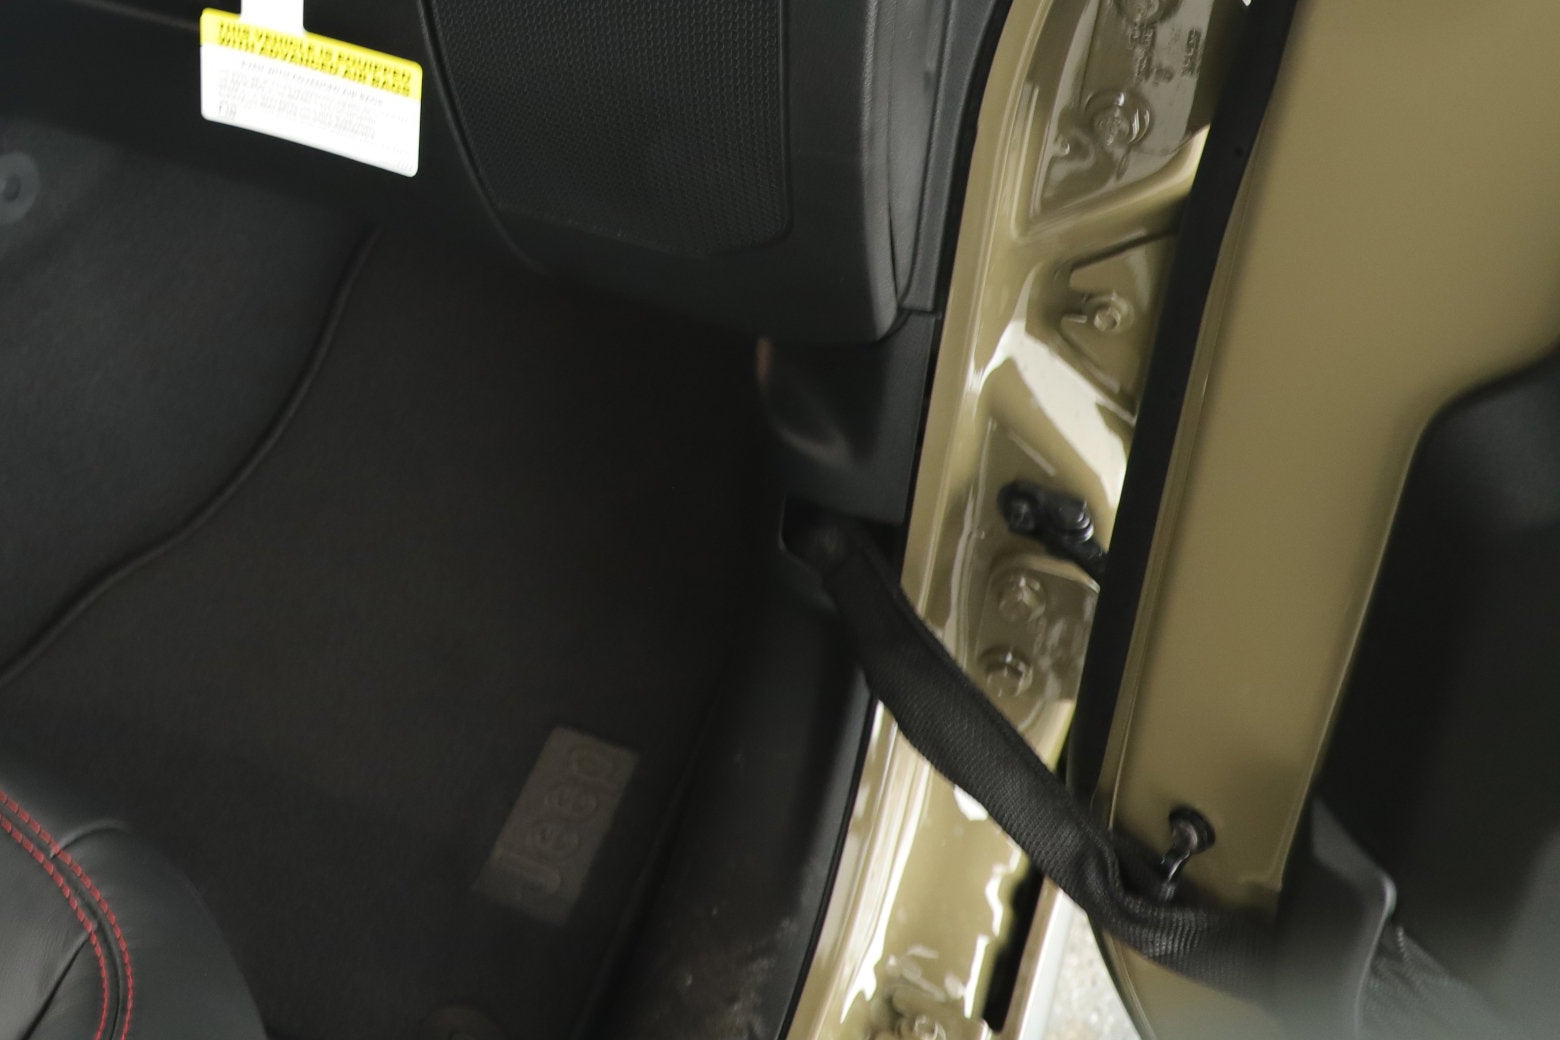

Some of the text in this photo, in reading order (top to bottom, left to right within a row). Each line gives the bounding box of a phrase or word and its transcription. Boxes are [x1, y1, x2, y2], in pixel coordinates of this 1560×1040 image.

[219, 21, 250, 40] THIS
[256, 31, 313, 57] VEHICLE
[336, 53, 411, 84] EQUIPPED
[219, 34, 411, 97] WITH ADVANCED AIR BAGS
